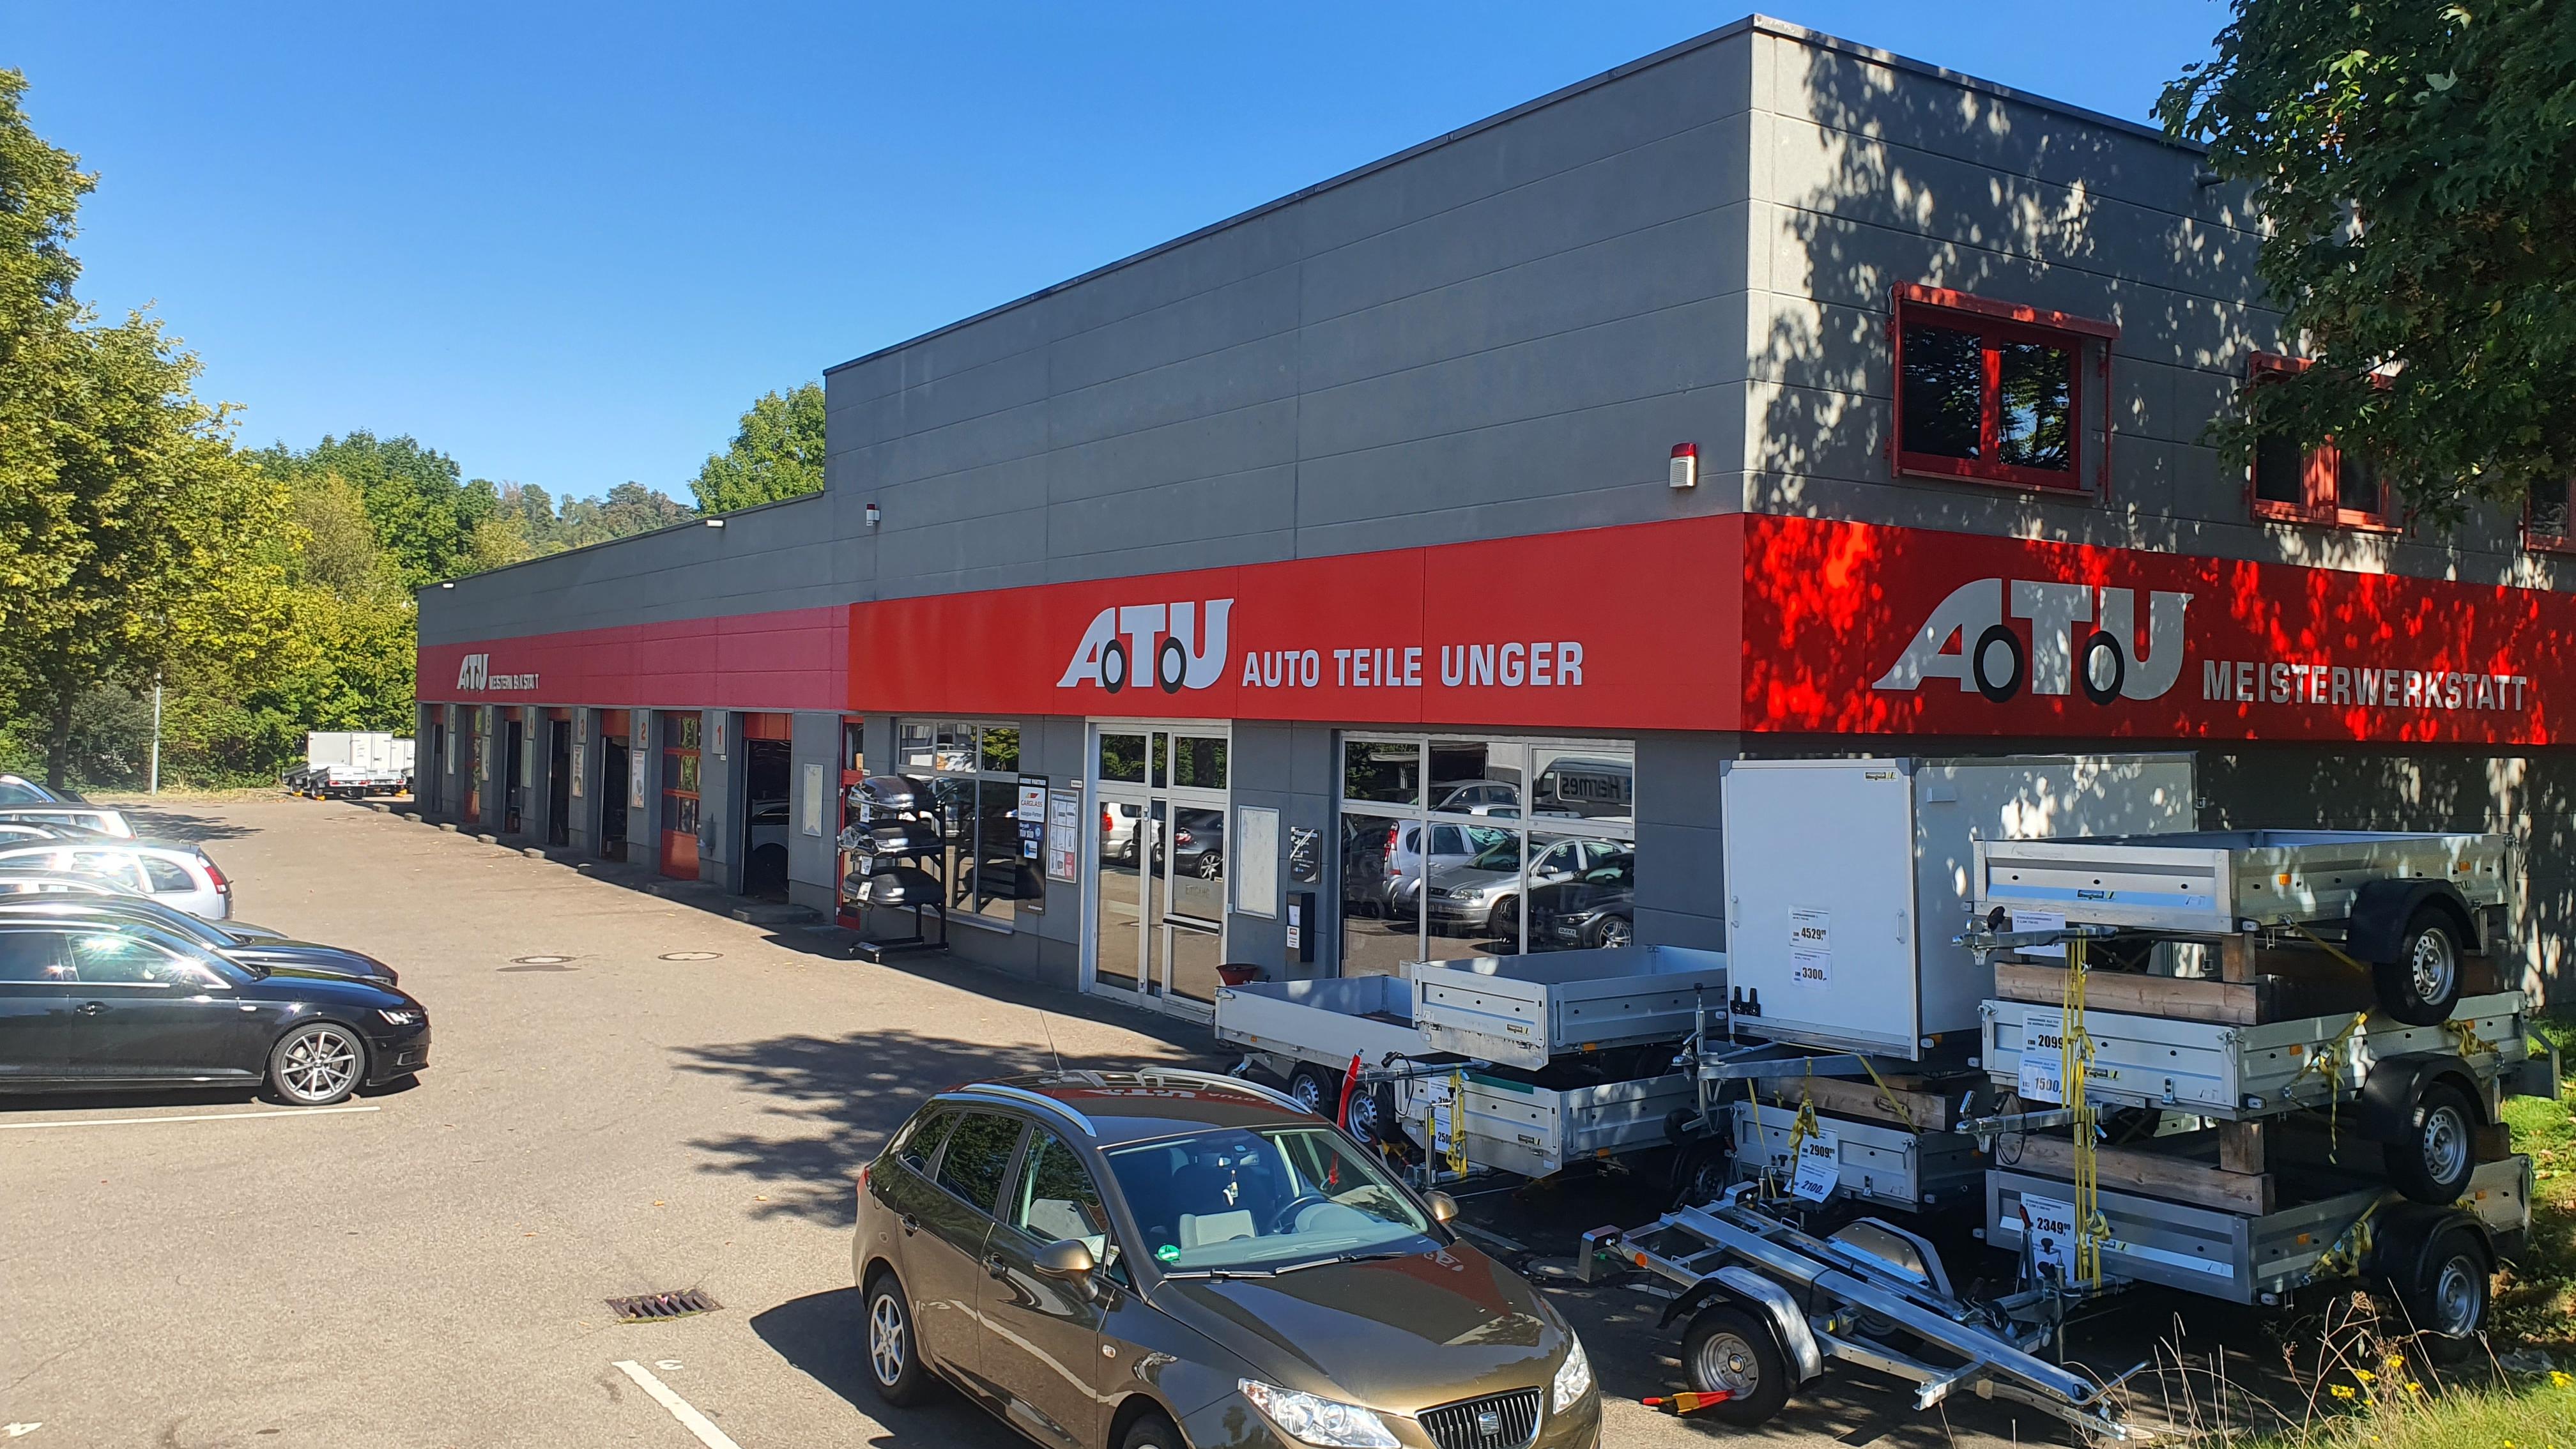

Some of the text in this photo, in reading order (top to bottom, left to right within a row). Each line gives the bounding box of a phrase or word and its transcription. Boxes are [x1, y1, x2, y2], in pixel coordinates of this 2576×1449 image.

[1056, 598, 1583, 694] ATU AUTO TEILE UNGER
[1871, 578, 2527, 710] ATU MEISTERWERKSTATT
[456, 654, 489, 691] ATU
[580, 719, 585, 735] 3
[641, 722, 647, 740] 2
[716, 725, 722, 745] 1
[1438, 1131, 1452, 1145] 2500
